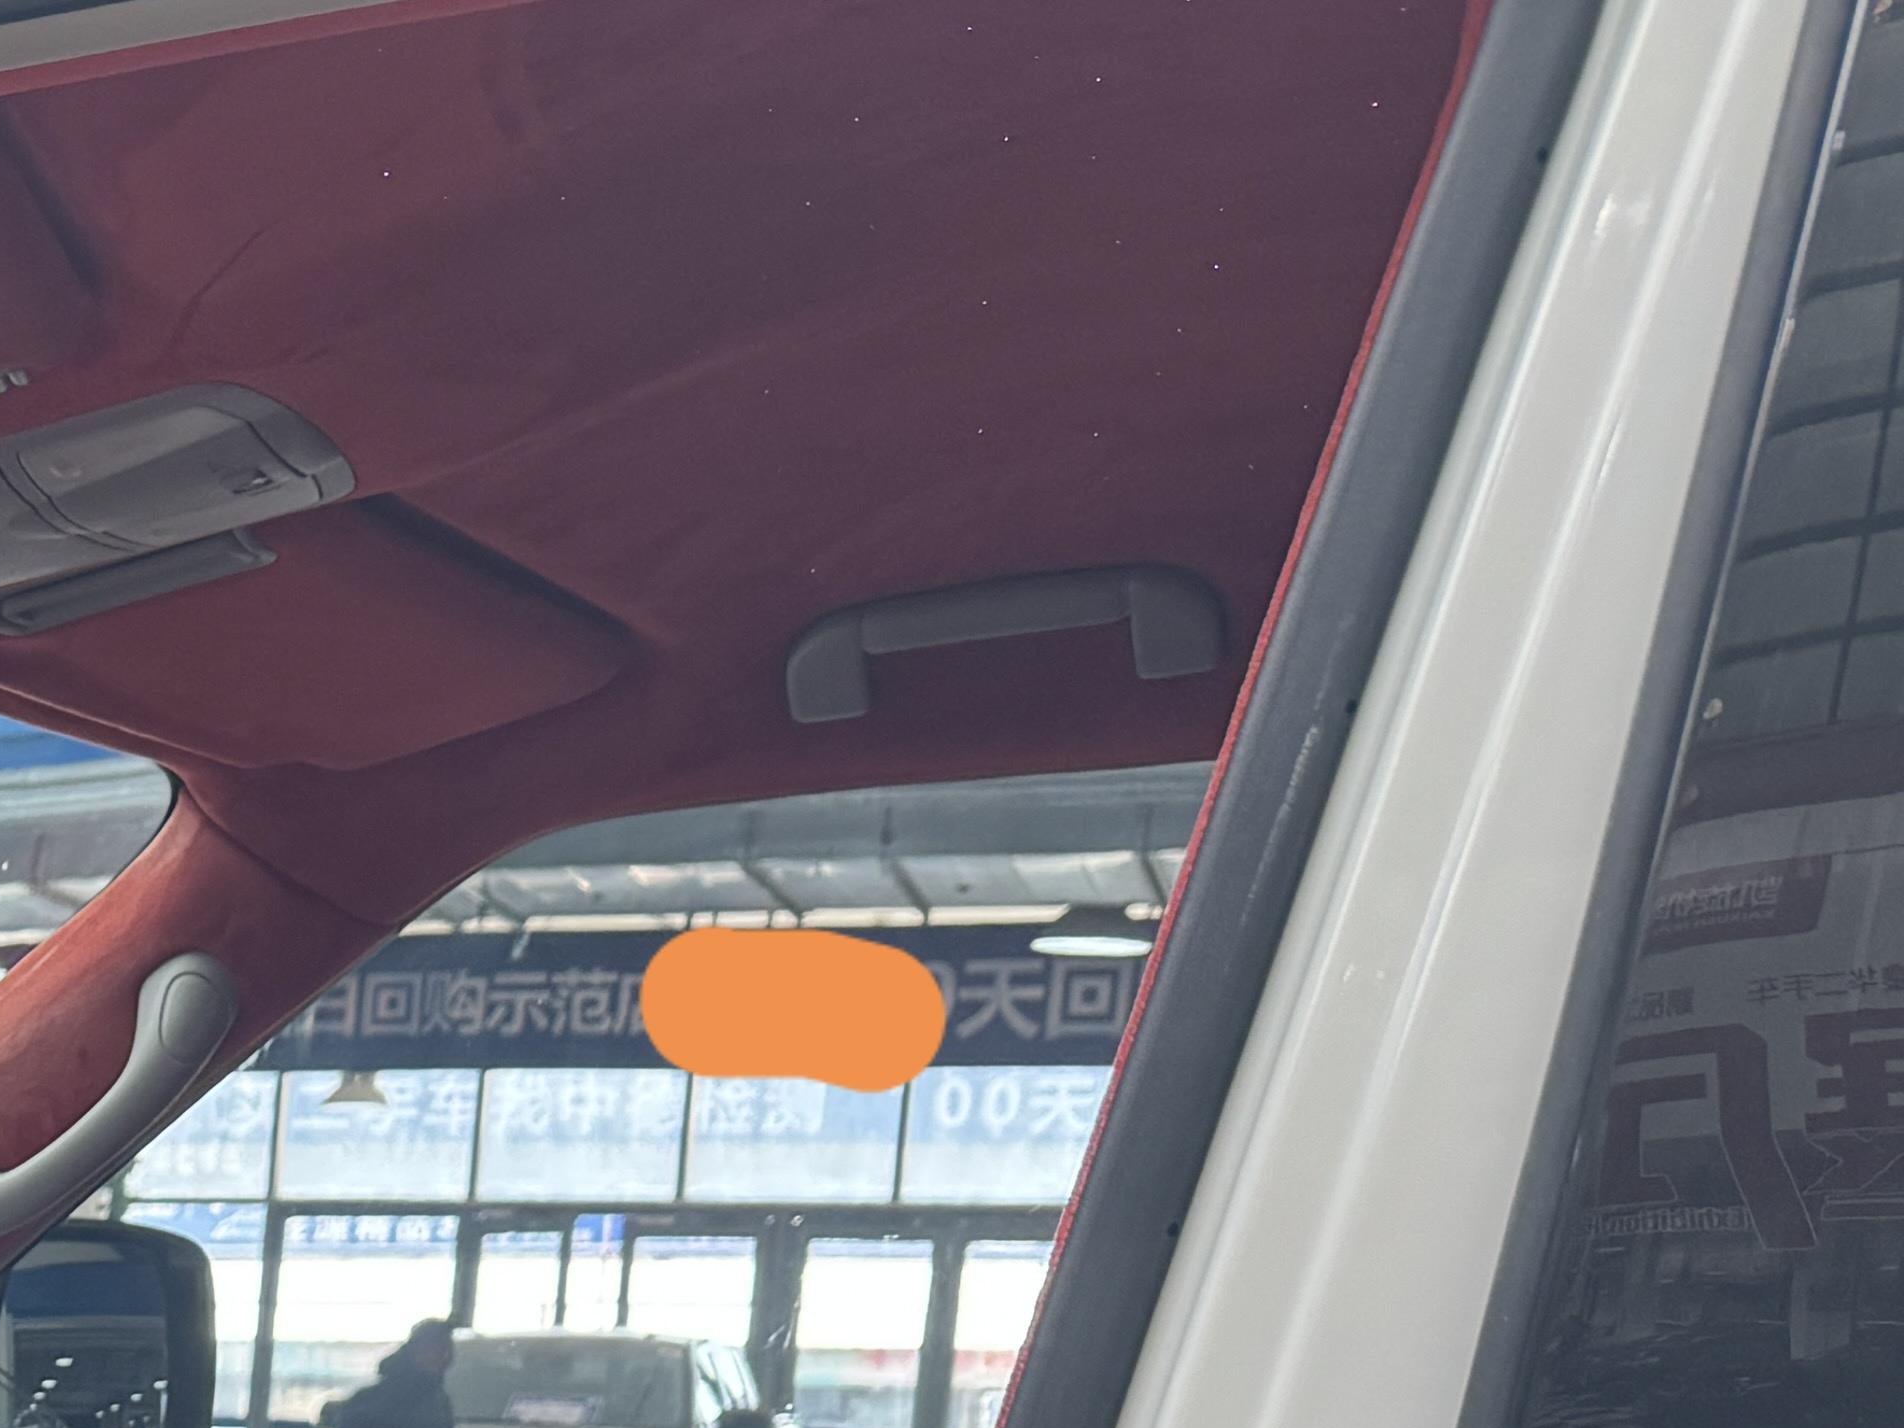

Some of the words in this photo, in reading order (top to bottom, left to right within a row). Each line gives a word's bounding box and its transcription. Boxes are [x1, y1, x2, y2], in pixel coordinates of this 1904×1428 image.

[304, 968, 642, 1037] 日回购示范
[927, 958, 1135, 1041] 天回
